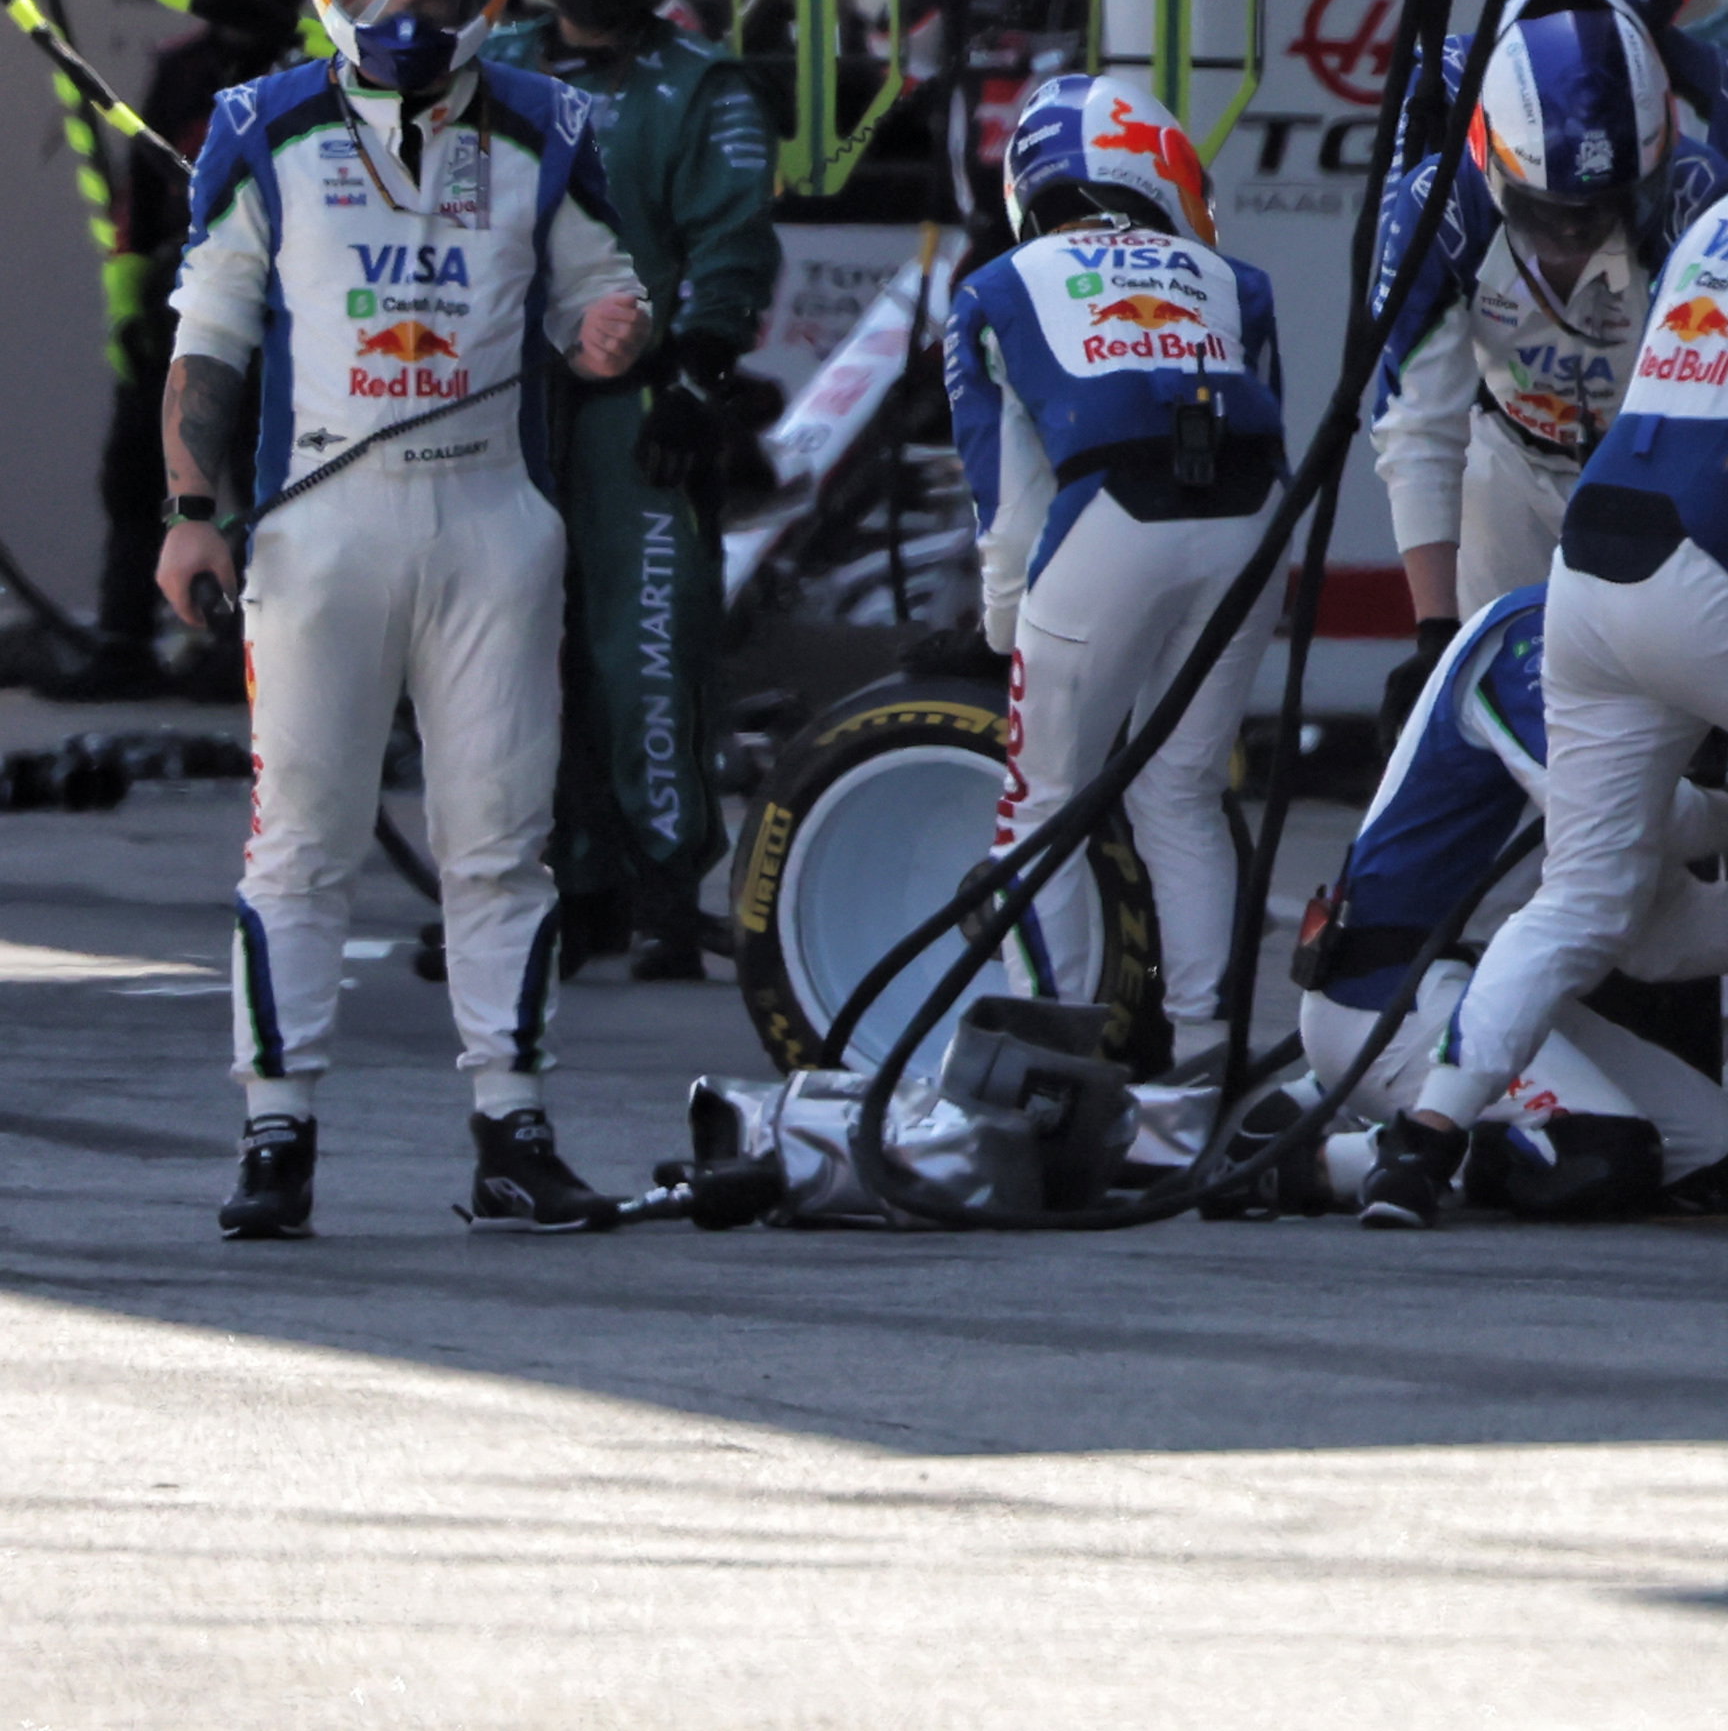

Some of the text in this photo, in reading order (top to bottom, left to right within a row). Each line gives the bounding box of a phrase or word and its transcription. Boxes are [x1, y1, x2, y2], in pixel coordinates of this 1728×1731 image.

[1238, 113, 1384, 176] TG
[439, 199, 477, 215] HUG
[347, 244, 470, 288] VISA
[1056, 247, 1203, 280] VISA
[1110, 274, 1208, 302] Cash App
[1083, 331, 1227, 364] Red Bull
[1516, 345, 1615, 383] VISA
[349, 367, 470, 400] Red Bull
[639, 511, 676, 680] MARTIN
[642, 694, 682, 843] ASTON
[739, 801, 794, 934] PIRELLI
[1100, 901, 1151, 1052] ZER
